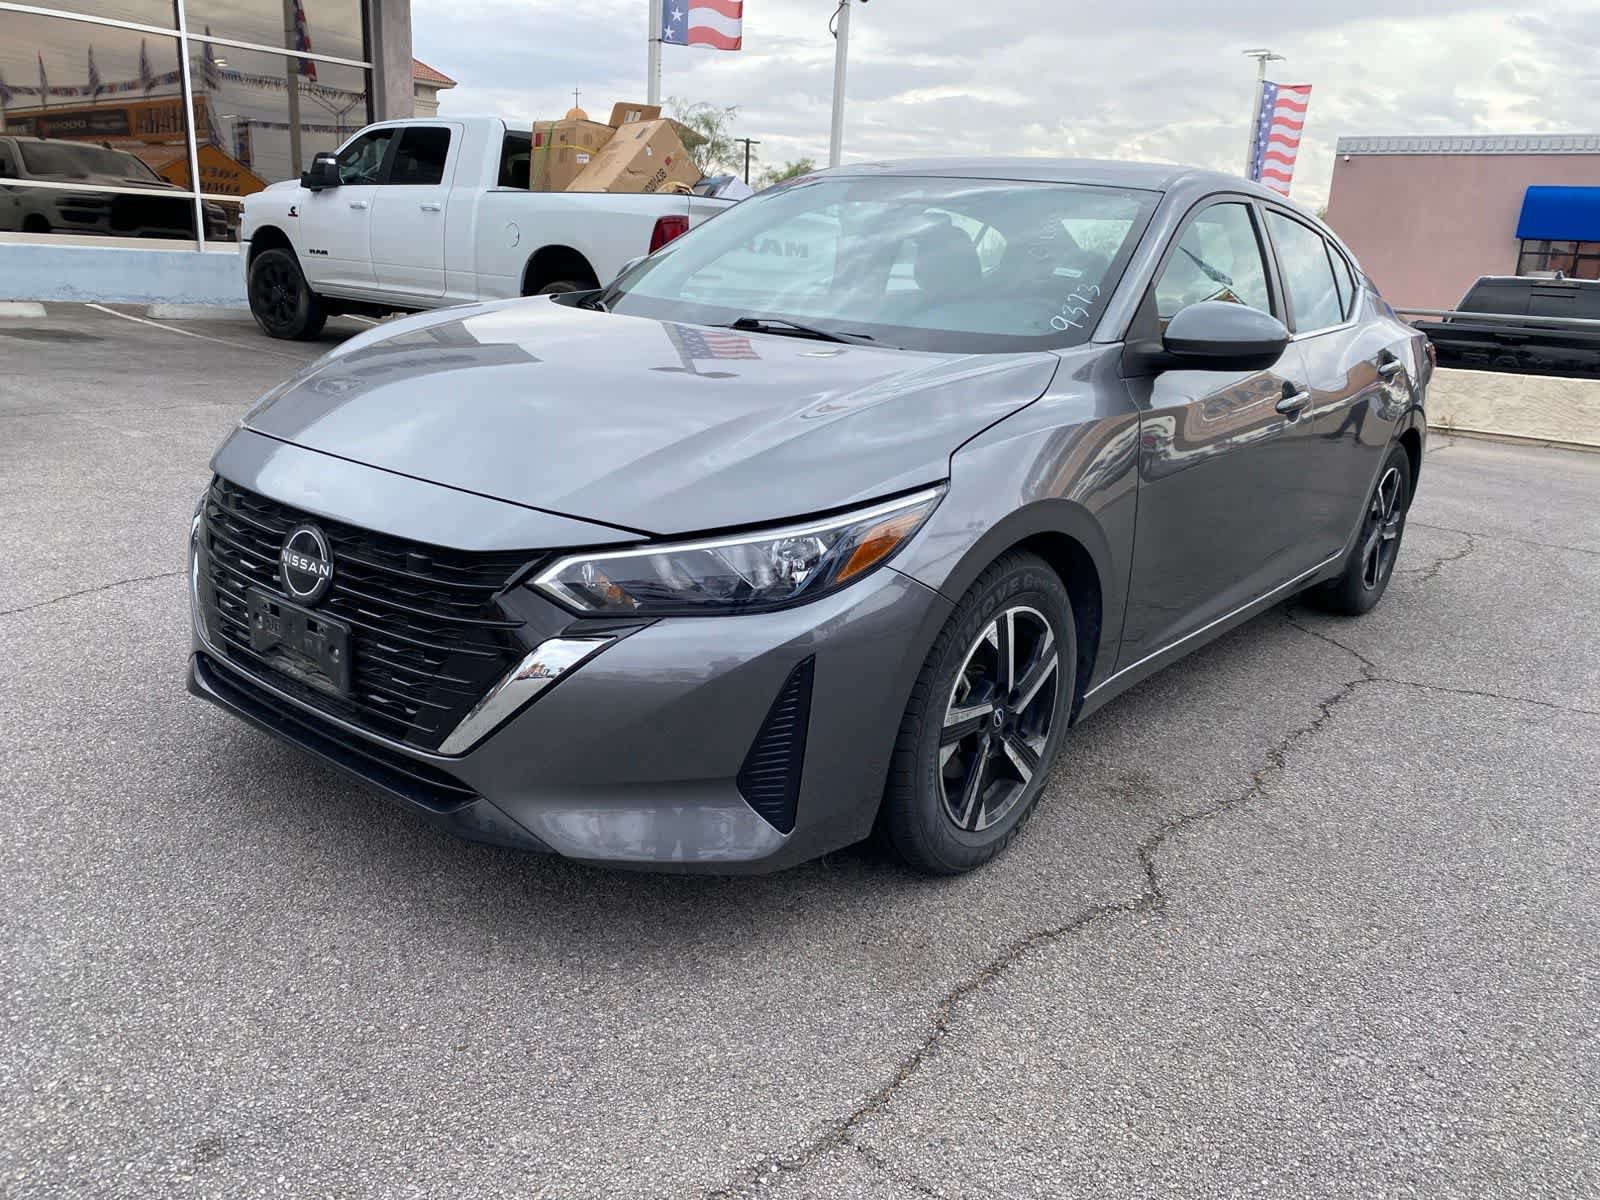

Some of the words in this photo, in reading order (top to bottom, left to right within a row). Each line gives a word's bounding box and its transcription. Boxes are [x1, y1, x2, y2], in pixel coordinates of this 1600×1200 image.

[309, 248, 329, 256] RAM
[1049, 284, 1101, 331] 9373
[282, 550, 330, 577] NISSAN
